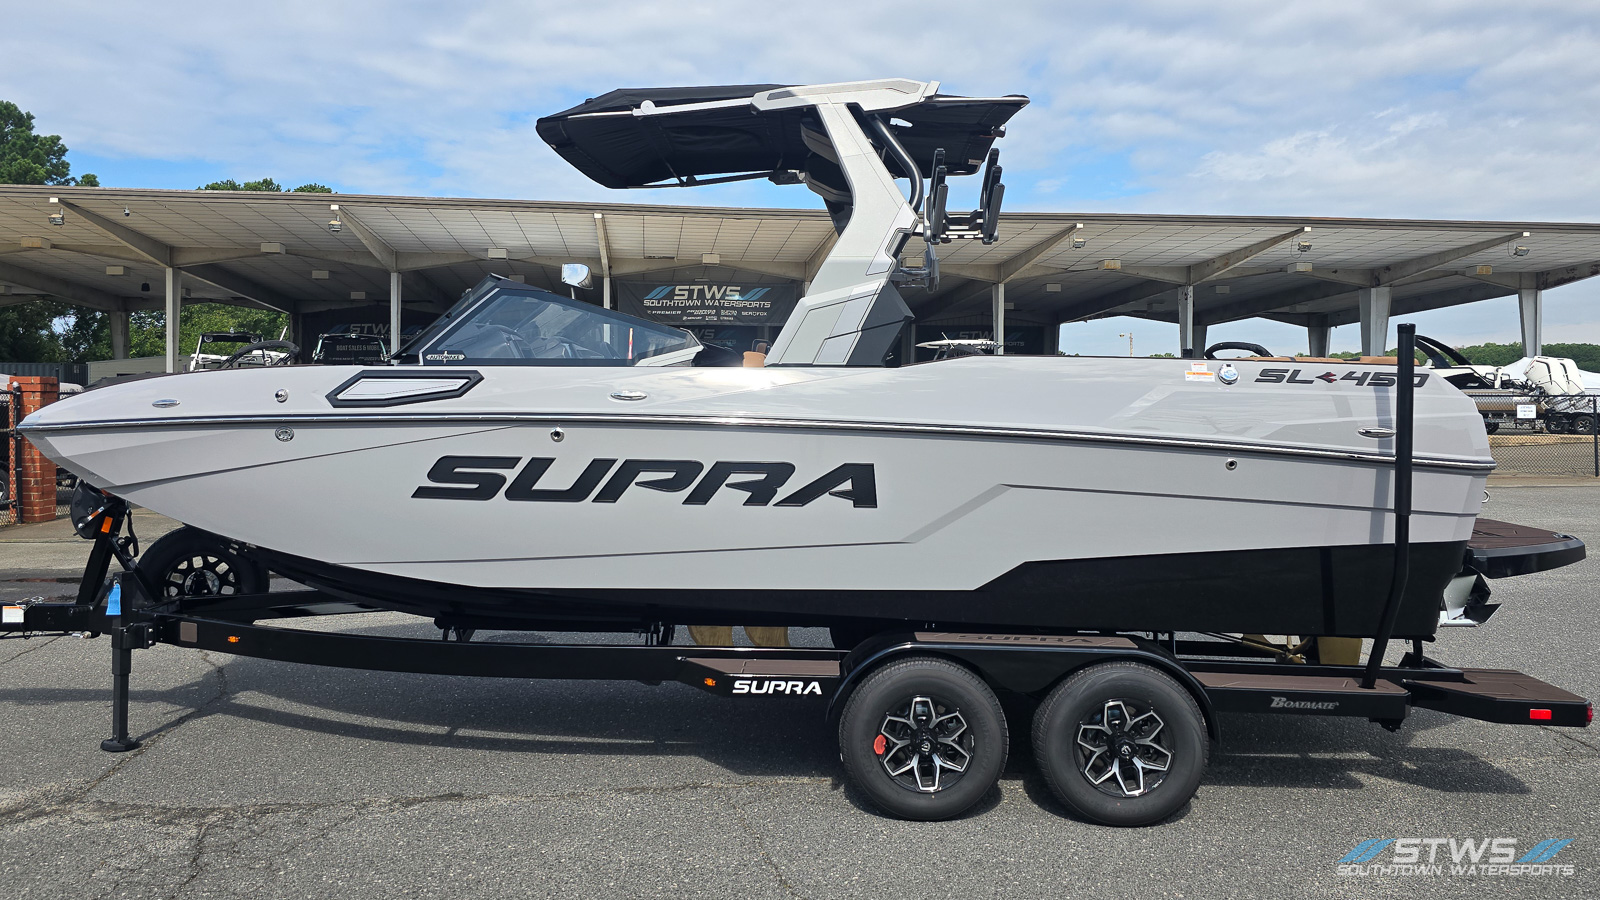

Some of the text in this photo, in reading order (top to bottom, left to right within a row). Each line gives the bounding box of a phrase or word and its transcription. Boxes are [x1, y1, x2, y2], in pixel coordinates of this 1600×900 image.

[673, 285, 741, 300] STWS
[643, 299, 771, 308] SOUTHTOWN WATERSPORTS
[350, 323, 391, 335] STW
[1254, 368, 1315, 384] SL
[411, 455, 878, 508] SUPRA
[732, 680, 822, 695] SUPRA
[1270, 696, 1336, 710] BOATMATE
